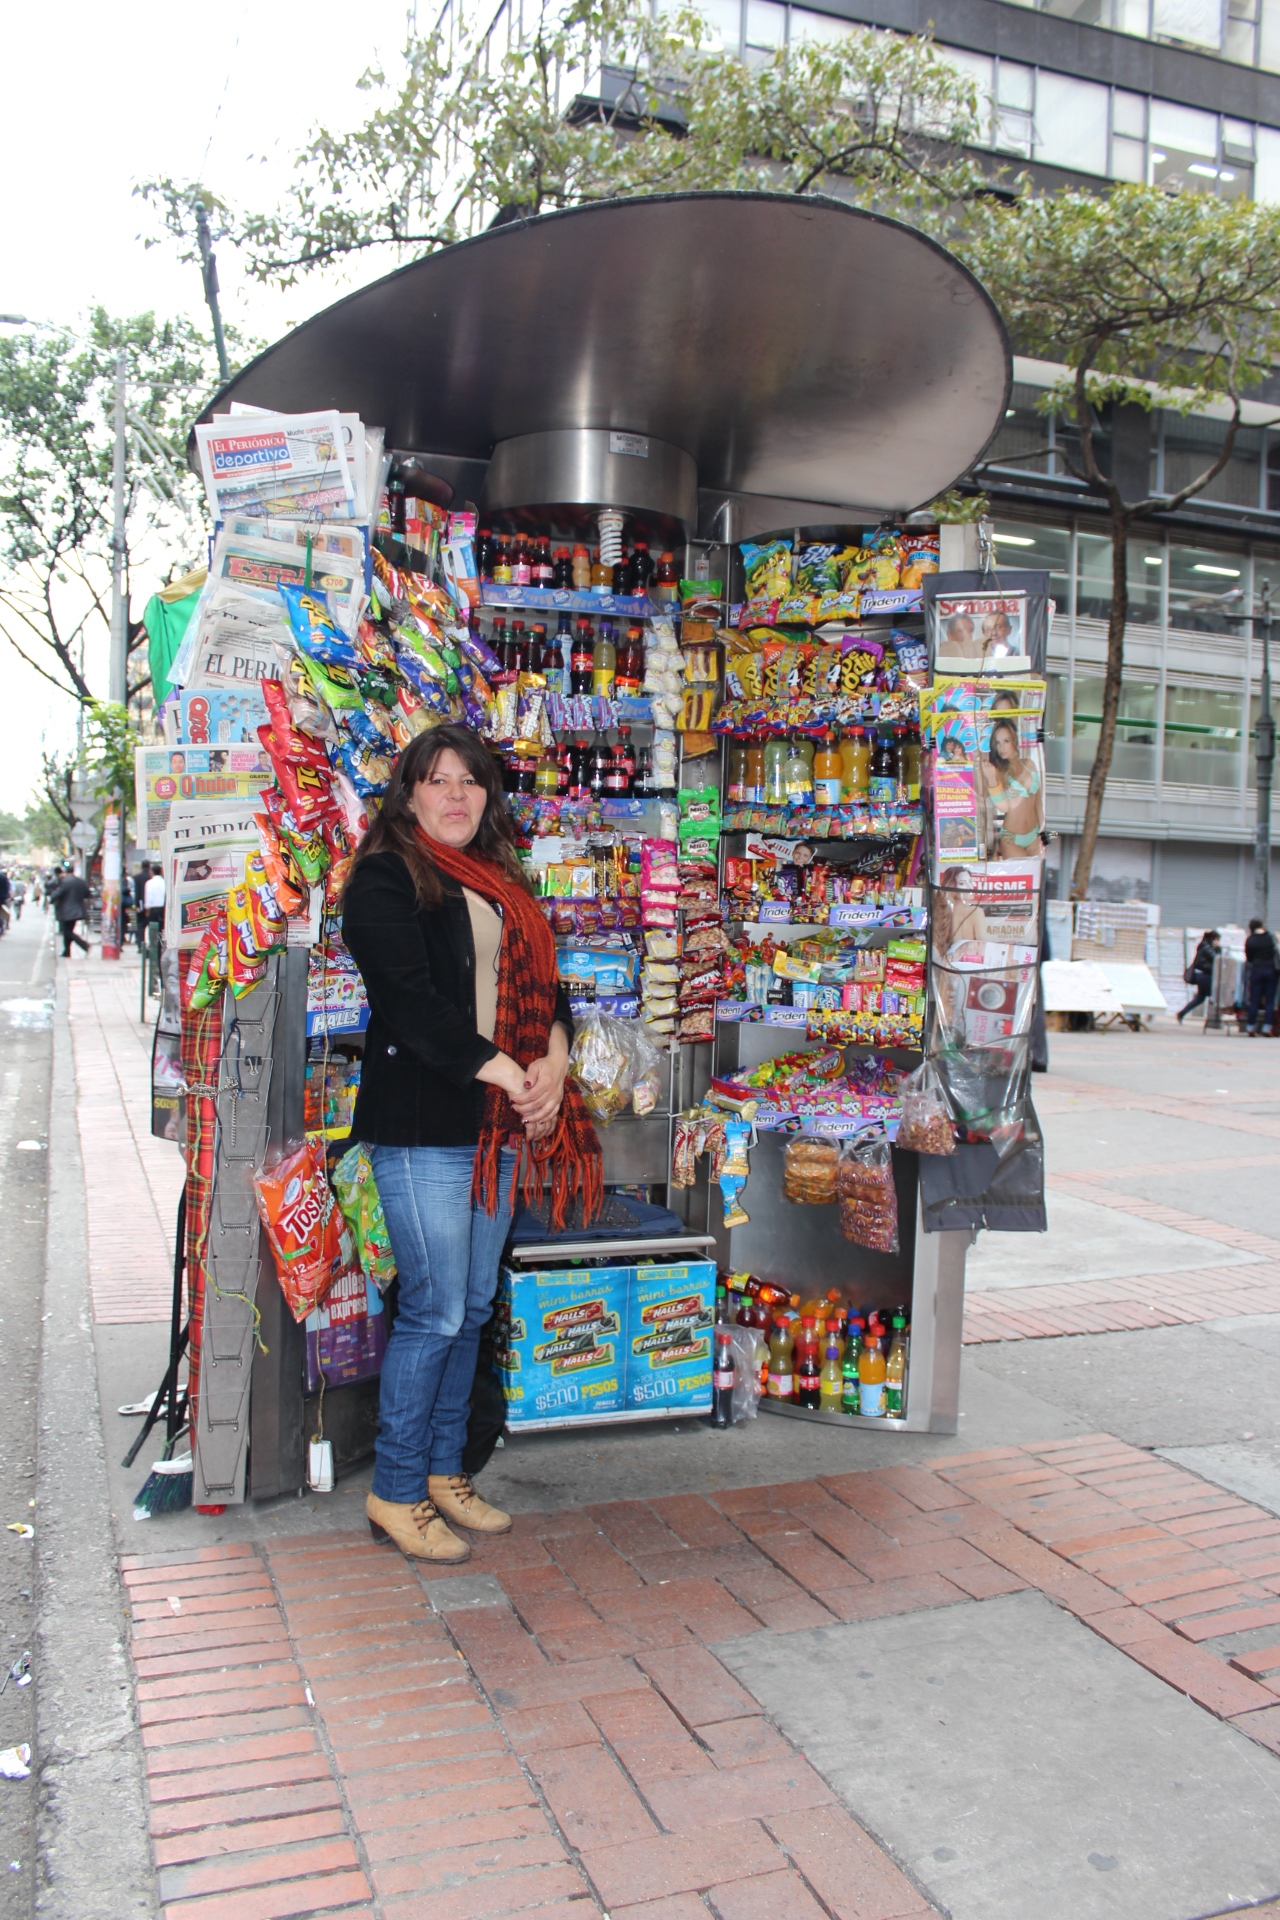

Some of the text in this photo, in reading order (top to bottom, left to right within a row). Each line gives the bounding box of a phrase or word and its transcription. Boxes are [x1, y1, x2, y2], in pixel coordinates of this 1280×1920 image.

[216, 448, 288, 467] deportivo
[325, 578, 344, 587] $700
[863, 595, 908, 609] Trident
[940, 600, 1019, 616] Semana
[206, 653, 281, 681] EL PERI
[838, 910, 882, 921] Trident
[986, 925, 1025, 935] ARIADNA
[893, 963, 914, 971] HALLS
[717, 1005, 741, 1015] rident
[313, 1009, 360, 1034] HALLS
[797, 1100, 837, 1116] Sparkies
[814, 1122, 856, 1132] Trident
[293, 1263, 307, 1275] 12
[571, 1286, 614, 1300] barras
[638, 1280, 710, 1303] mini barras
[331, 1296, 367, 1321] express
[653, 1303, 684, 1318] HALLS
[554, 1309, 586, 1324] HALLS
[665, 1317, 696, 1330] HALLS
[567, 1322, 598, 1337] HALLS
[545, 1341, 576, 1357] HALLS
[643, 1334, 674, 1349] HALLS
[563, 1352, 594, 1367] HALLS
[661, 1346, 691, 1360] HALLS
[536, 1386, 579, 1410] $500
[581, 1378, 618, 1399] PESOS
[633, 1372, 712, 1402] $500 PESOS
